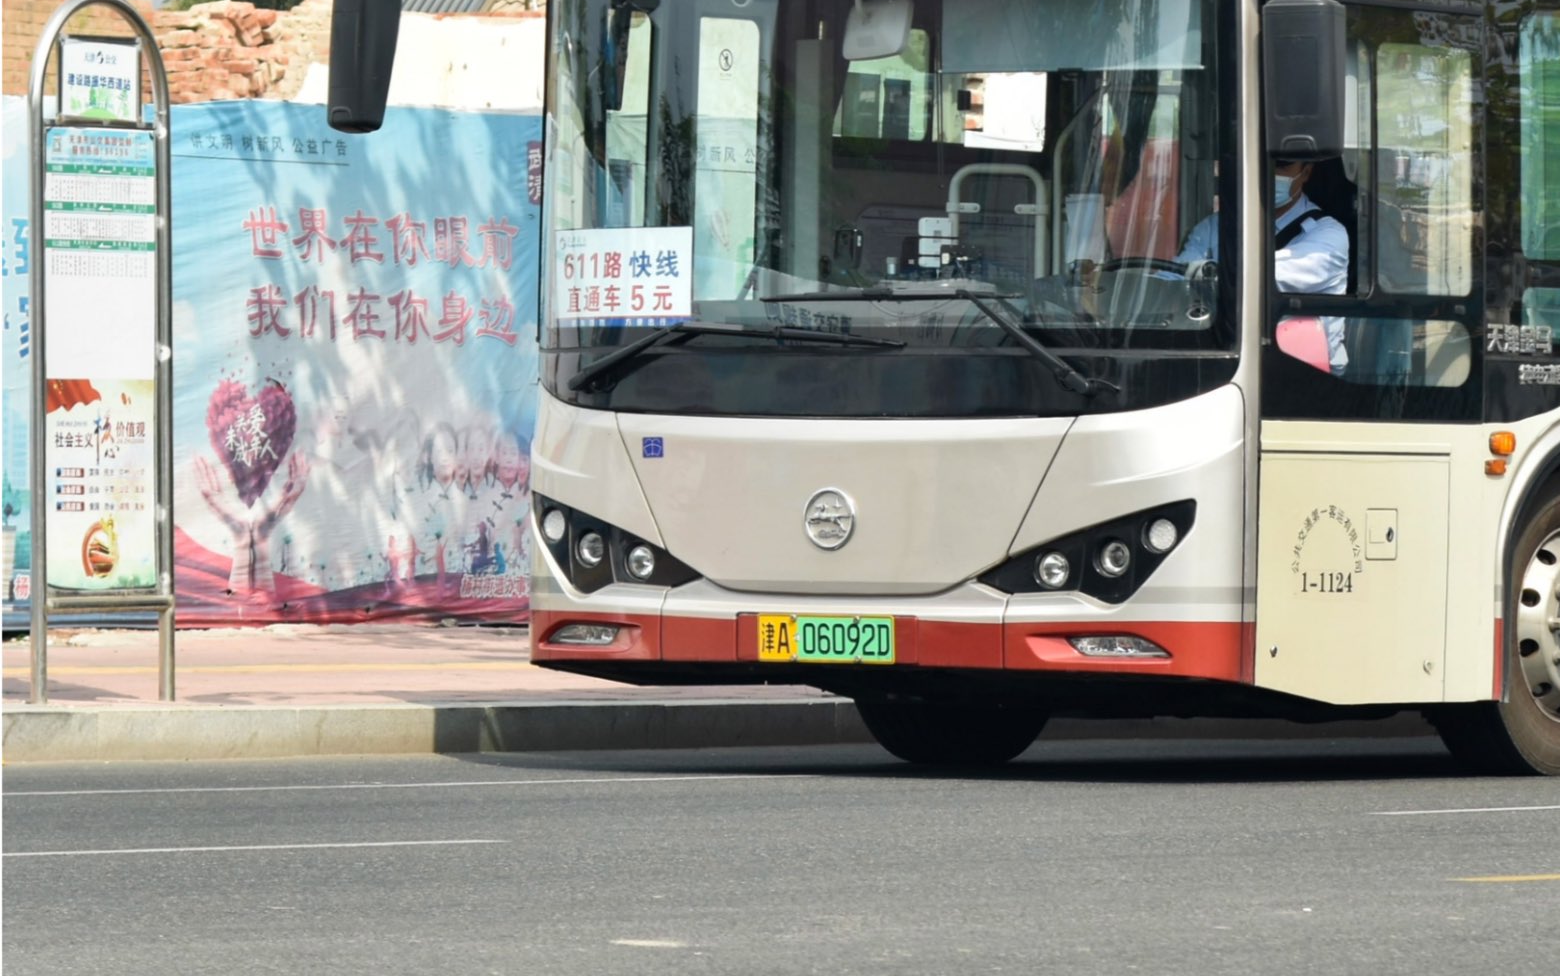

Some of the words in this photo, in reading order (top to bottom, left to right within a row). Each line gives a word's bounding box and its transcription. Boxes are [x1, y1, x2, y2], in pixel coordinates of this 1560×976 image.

[242, 136, 284, 153] 树新风
[293, 138, 348, 156] 公益广告
[243, 206, 519, 272] 世界在你眼前
[564, 251, 622, 280] 611路
[629, 250, 680, 278] 快线
[567, 284, 621, 313] 直通车
[246, 284, 519, 347] 我们在你身边
[56, 432, 94, 448] 社会主义
[1301, 571, 1353, 593] 1-1124
[761, 622, 791, 654] 津A
[802, 622, 890, 656] 06092D
